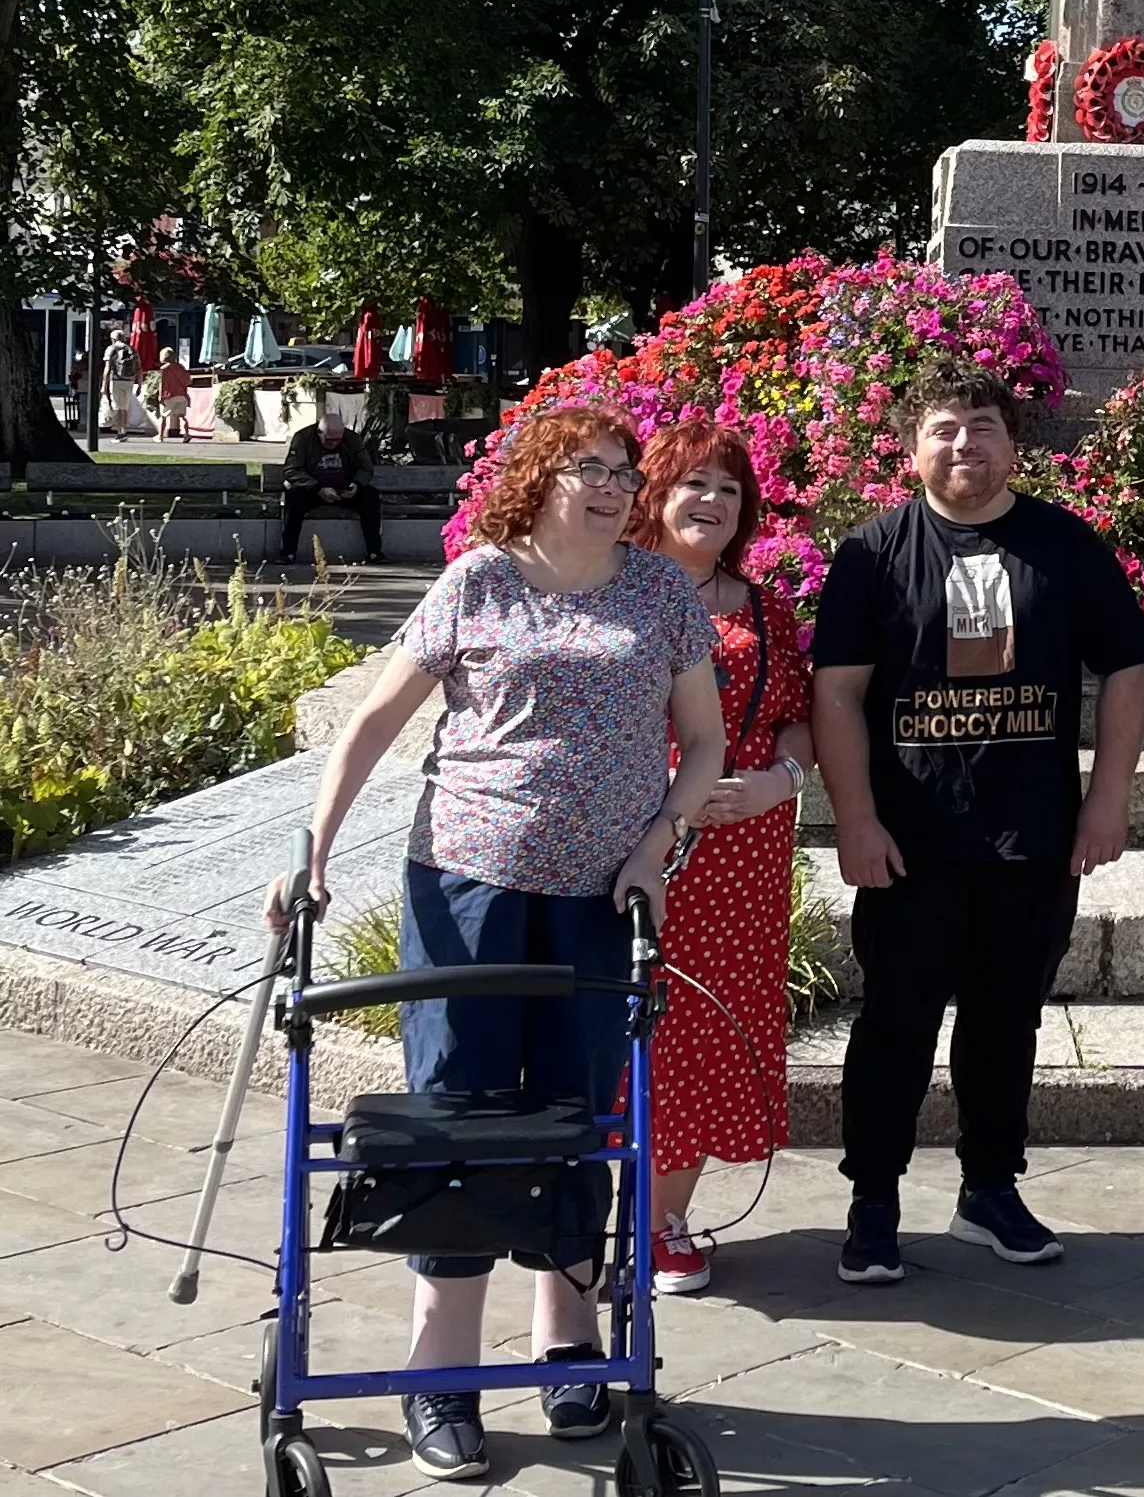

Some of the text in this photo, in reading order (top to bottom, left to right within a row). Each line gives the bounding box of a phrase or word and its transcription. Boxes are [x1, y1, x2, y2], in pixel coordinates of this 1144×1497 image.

[1073, 171, 1127, 196] 1914
[1072, 209, 1096, 230] IN
[959, 237, 995, 259] OF
[1009, 240, 1071, 261] OUR
[1046, 270, 1125, 293] THEIR
[1055, 334, 1084, 352] YE
[914, 685, 1046, 708] POWERED BY
[899, 710, 1053, 738] CHOCCY MILK
[5, 901, 143, 941] WORLD
[139, 932, 236, 964] WAR
